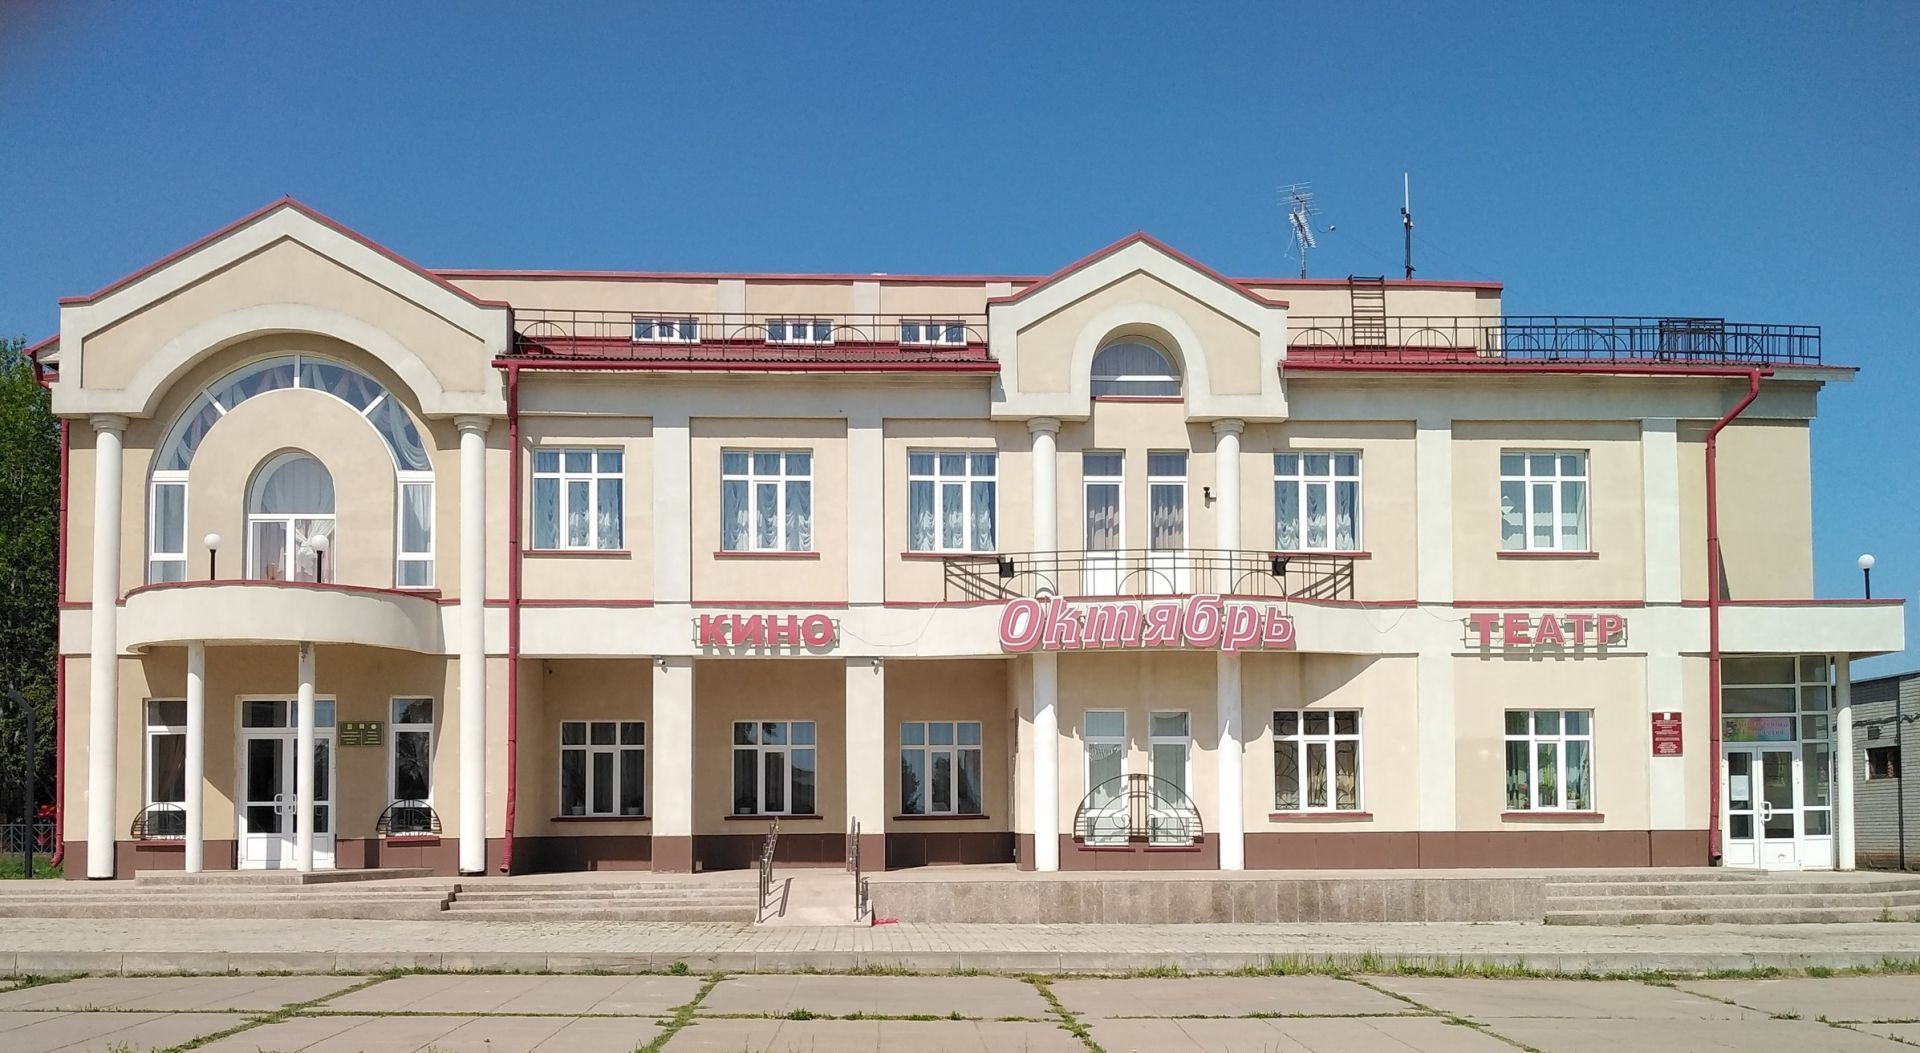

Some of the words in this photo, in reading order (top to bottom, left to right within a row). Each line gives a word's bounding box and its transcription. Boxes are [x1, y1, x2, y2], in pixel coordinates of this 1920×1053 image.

[700, 614, 834, 646] КИНО
[1000, 594, 1295, 655] Октябрь
[1470, 613, 1624, 645] ТЕАТР
